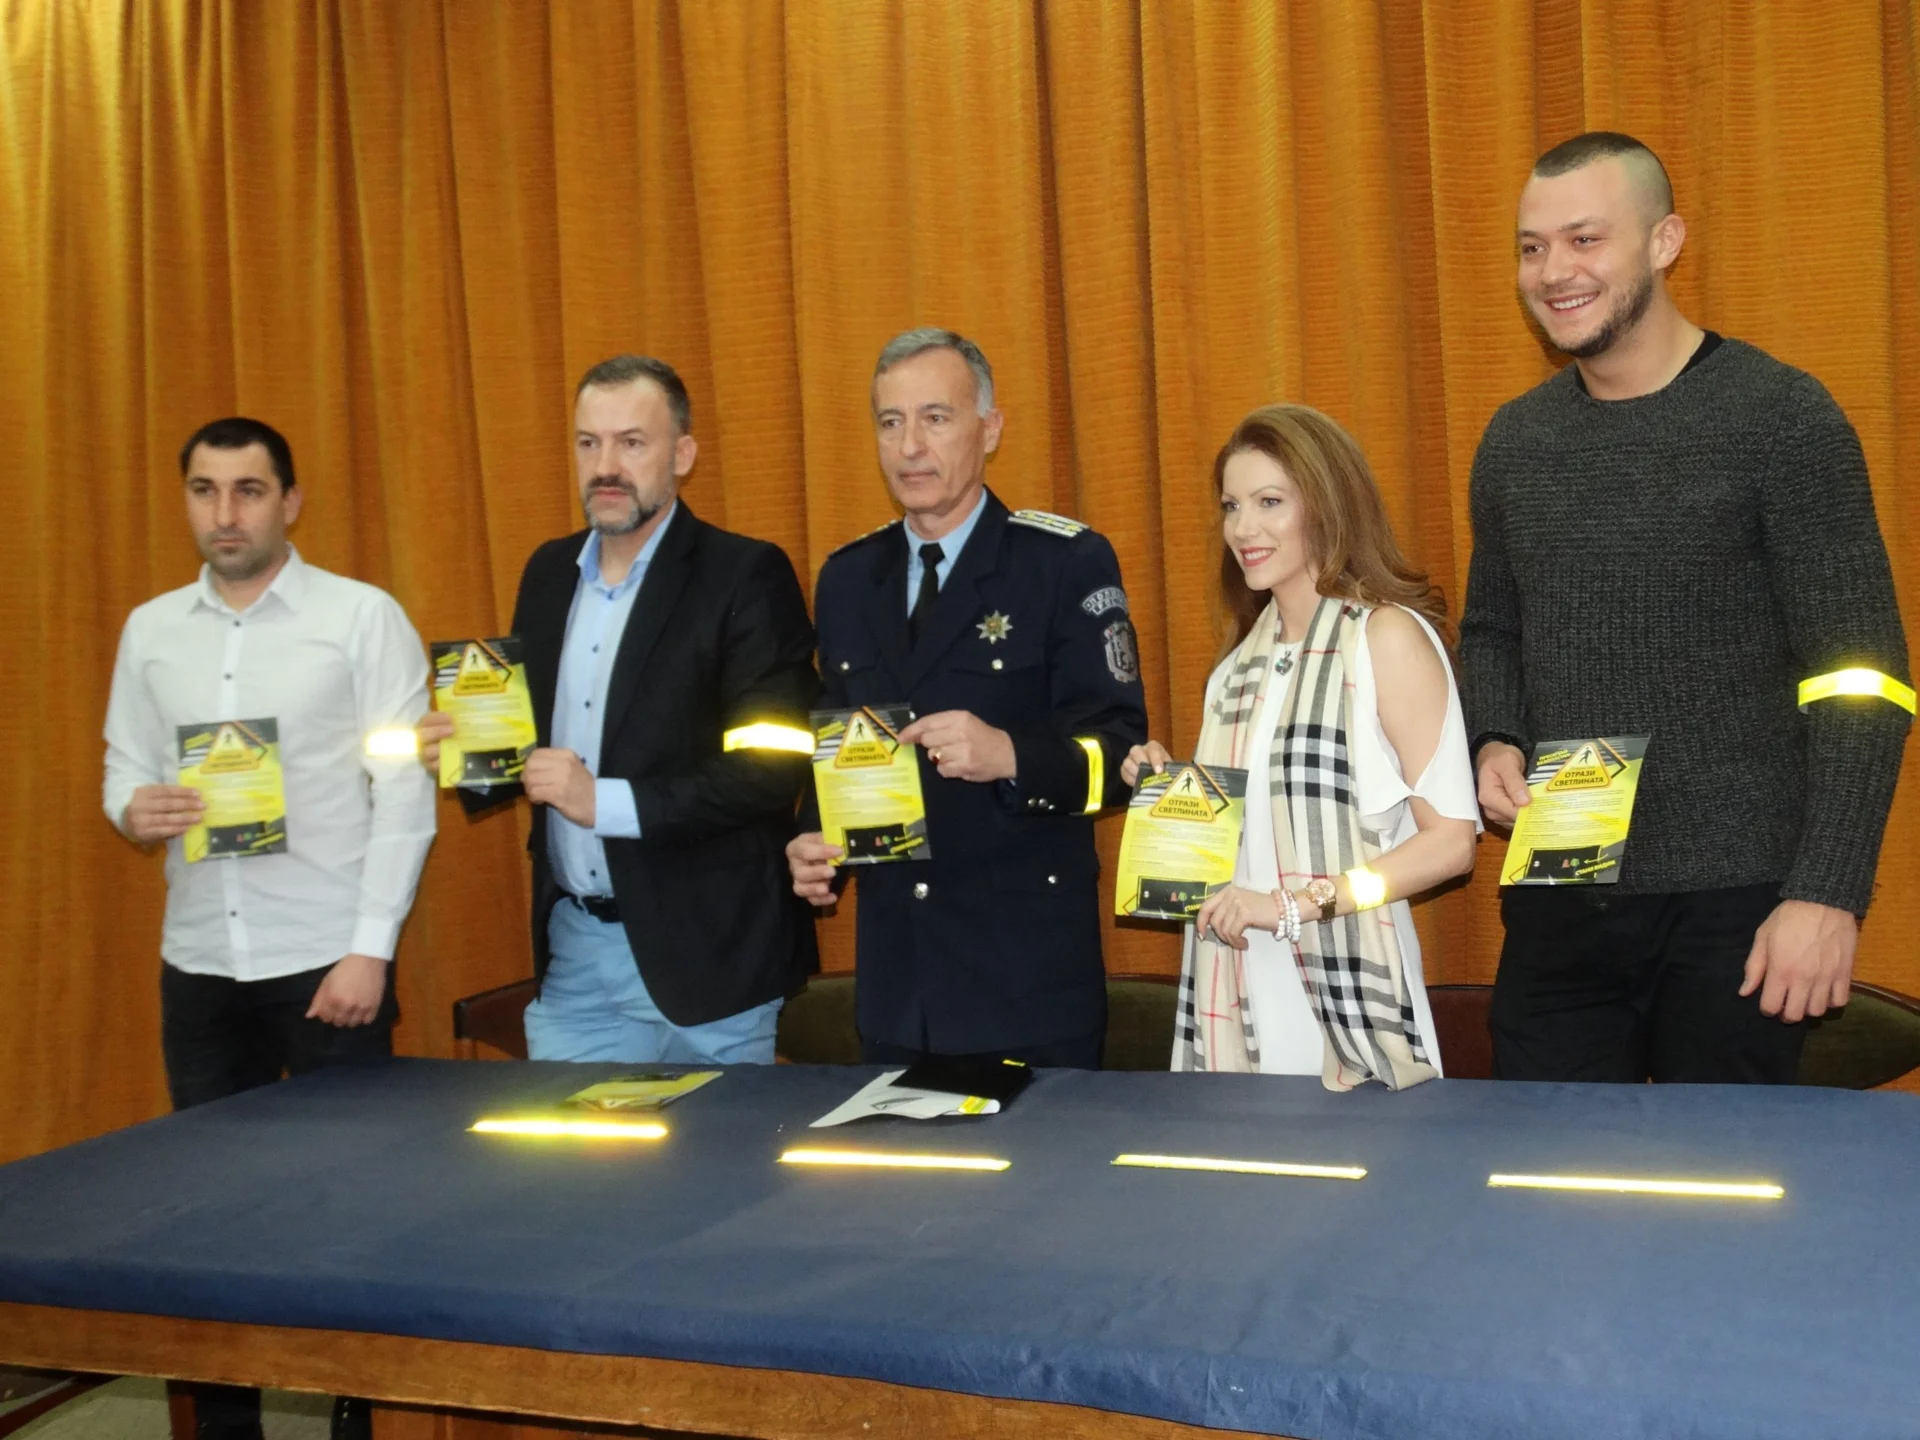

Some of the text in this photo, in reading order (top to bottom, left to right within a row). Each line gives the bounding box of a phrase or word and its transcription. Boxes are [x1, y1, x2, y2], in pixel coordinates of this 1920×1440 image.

[1563, 770, 1597, 779] ОТРАЗИ
[1554, 776, 1605, 787] СВЕТЛИНАТА
[1168, 799, 1200, 809] ОТРАЗИ
[1158, 806, 1209, 818] СВЕТЛИНАТА
